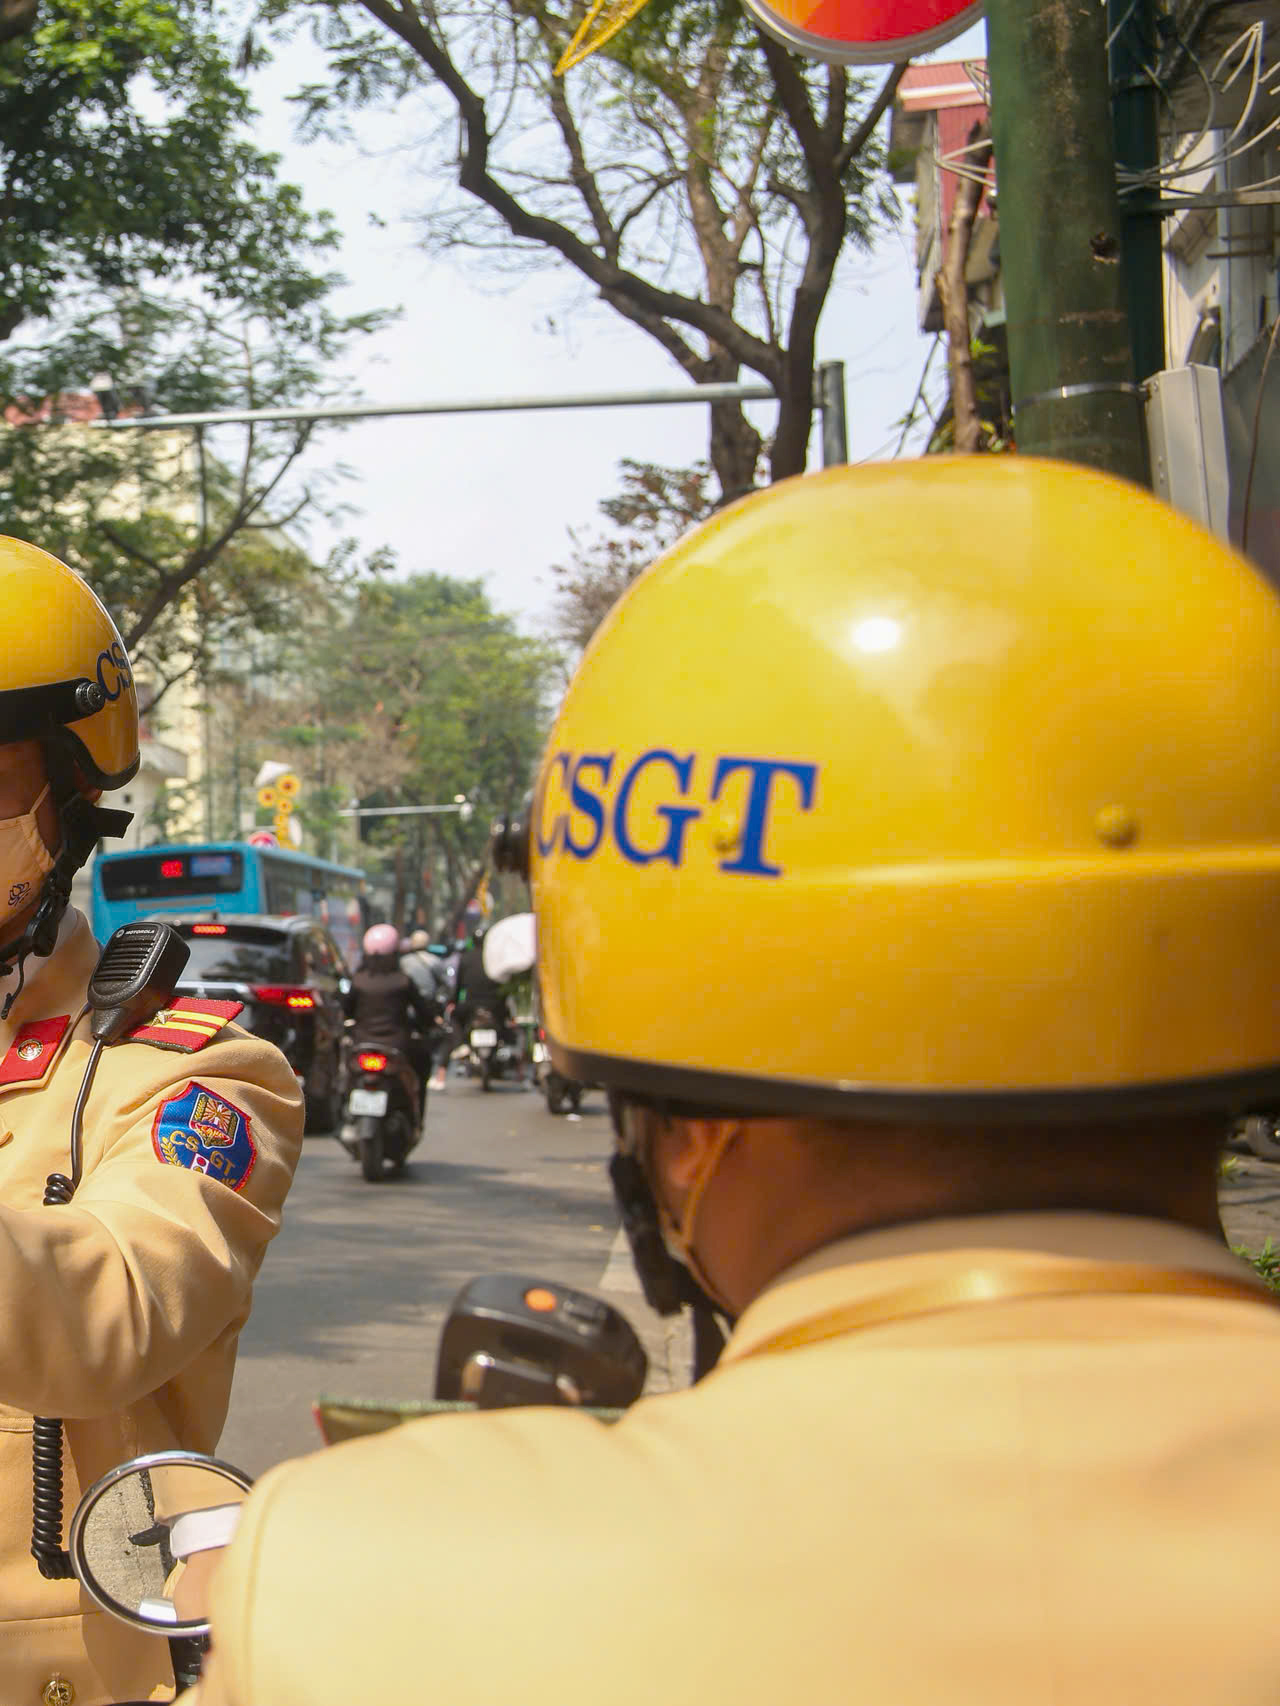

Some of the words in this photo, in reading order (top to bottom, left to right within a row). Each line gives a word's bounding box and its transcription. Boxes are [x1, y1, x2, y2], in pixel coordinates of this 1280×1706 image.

[534, 749, 819, 878] CSGT
[169, 1130, 200, 1153] CS
[209, 1150, 236, 1175] GT
